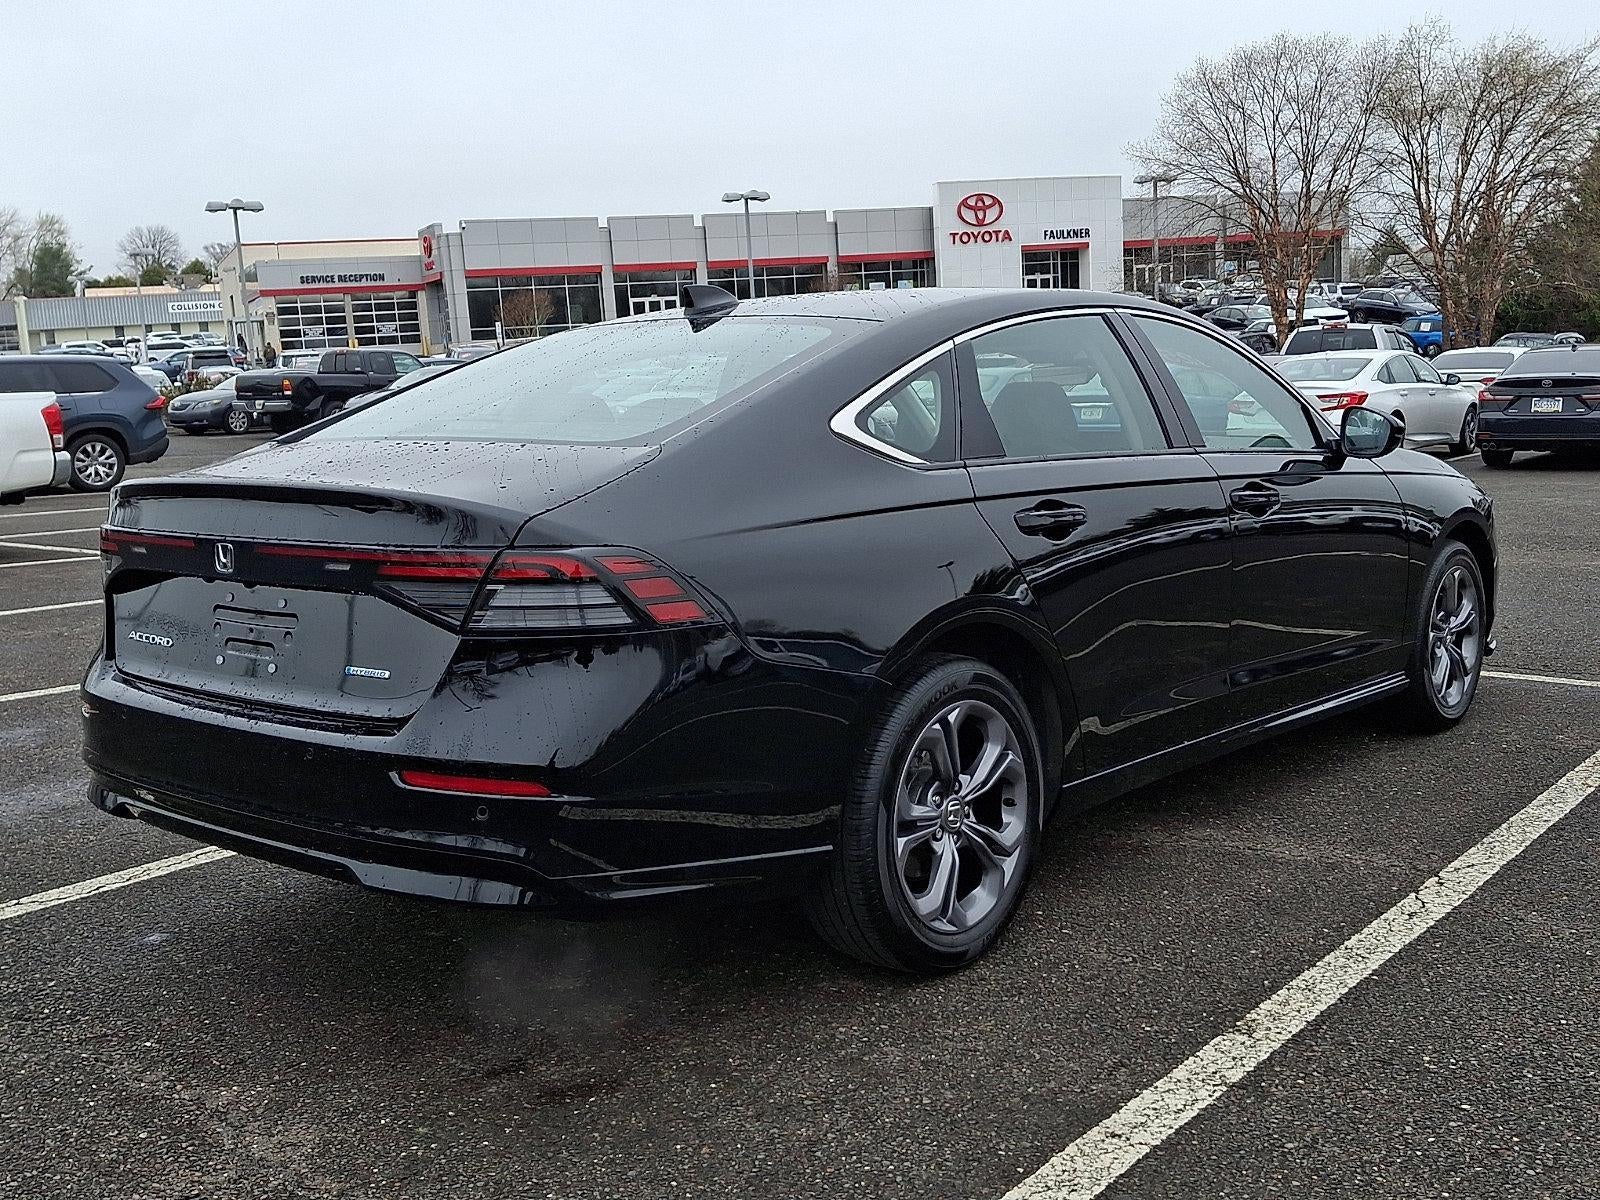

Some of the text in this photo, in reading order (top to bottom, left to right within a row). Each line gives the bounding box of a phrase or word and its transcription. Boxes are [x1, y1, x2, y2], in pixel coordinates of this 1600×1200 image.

[949, 229, 1013, 245] TOYOTA
[1043, 227, 1091, 241] FAULKNER
[299, 272, 385, 284] SERVICE RECEPTION
[171, 302, 216, 311] COLLISION
[128, 630, 173, 647] ACCORD
[351, 668, 386, 677] HYBRID
